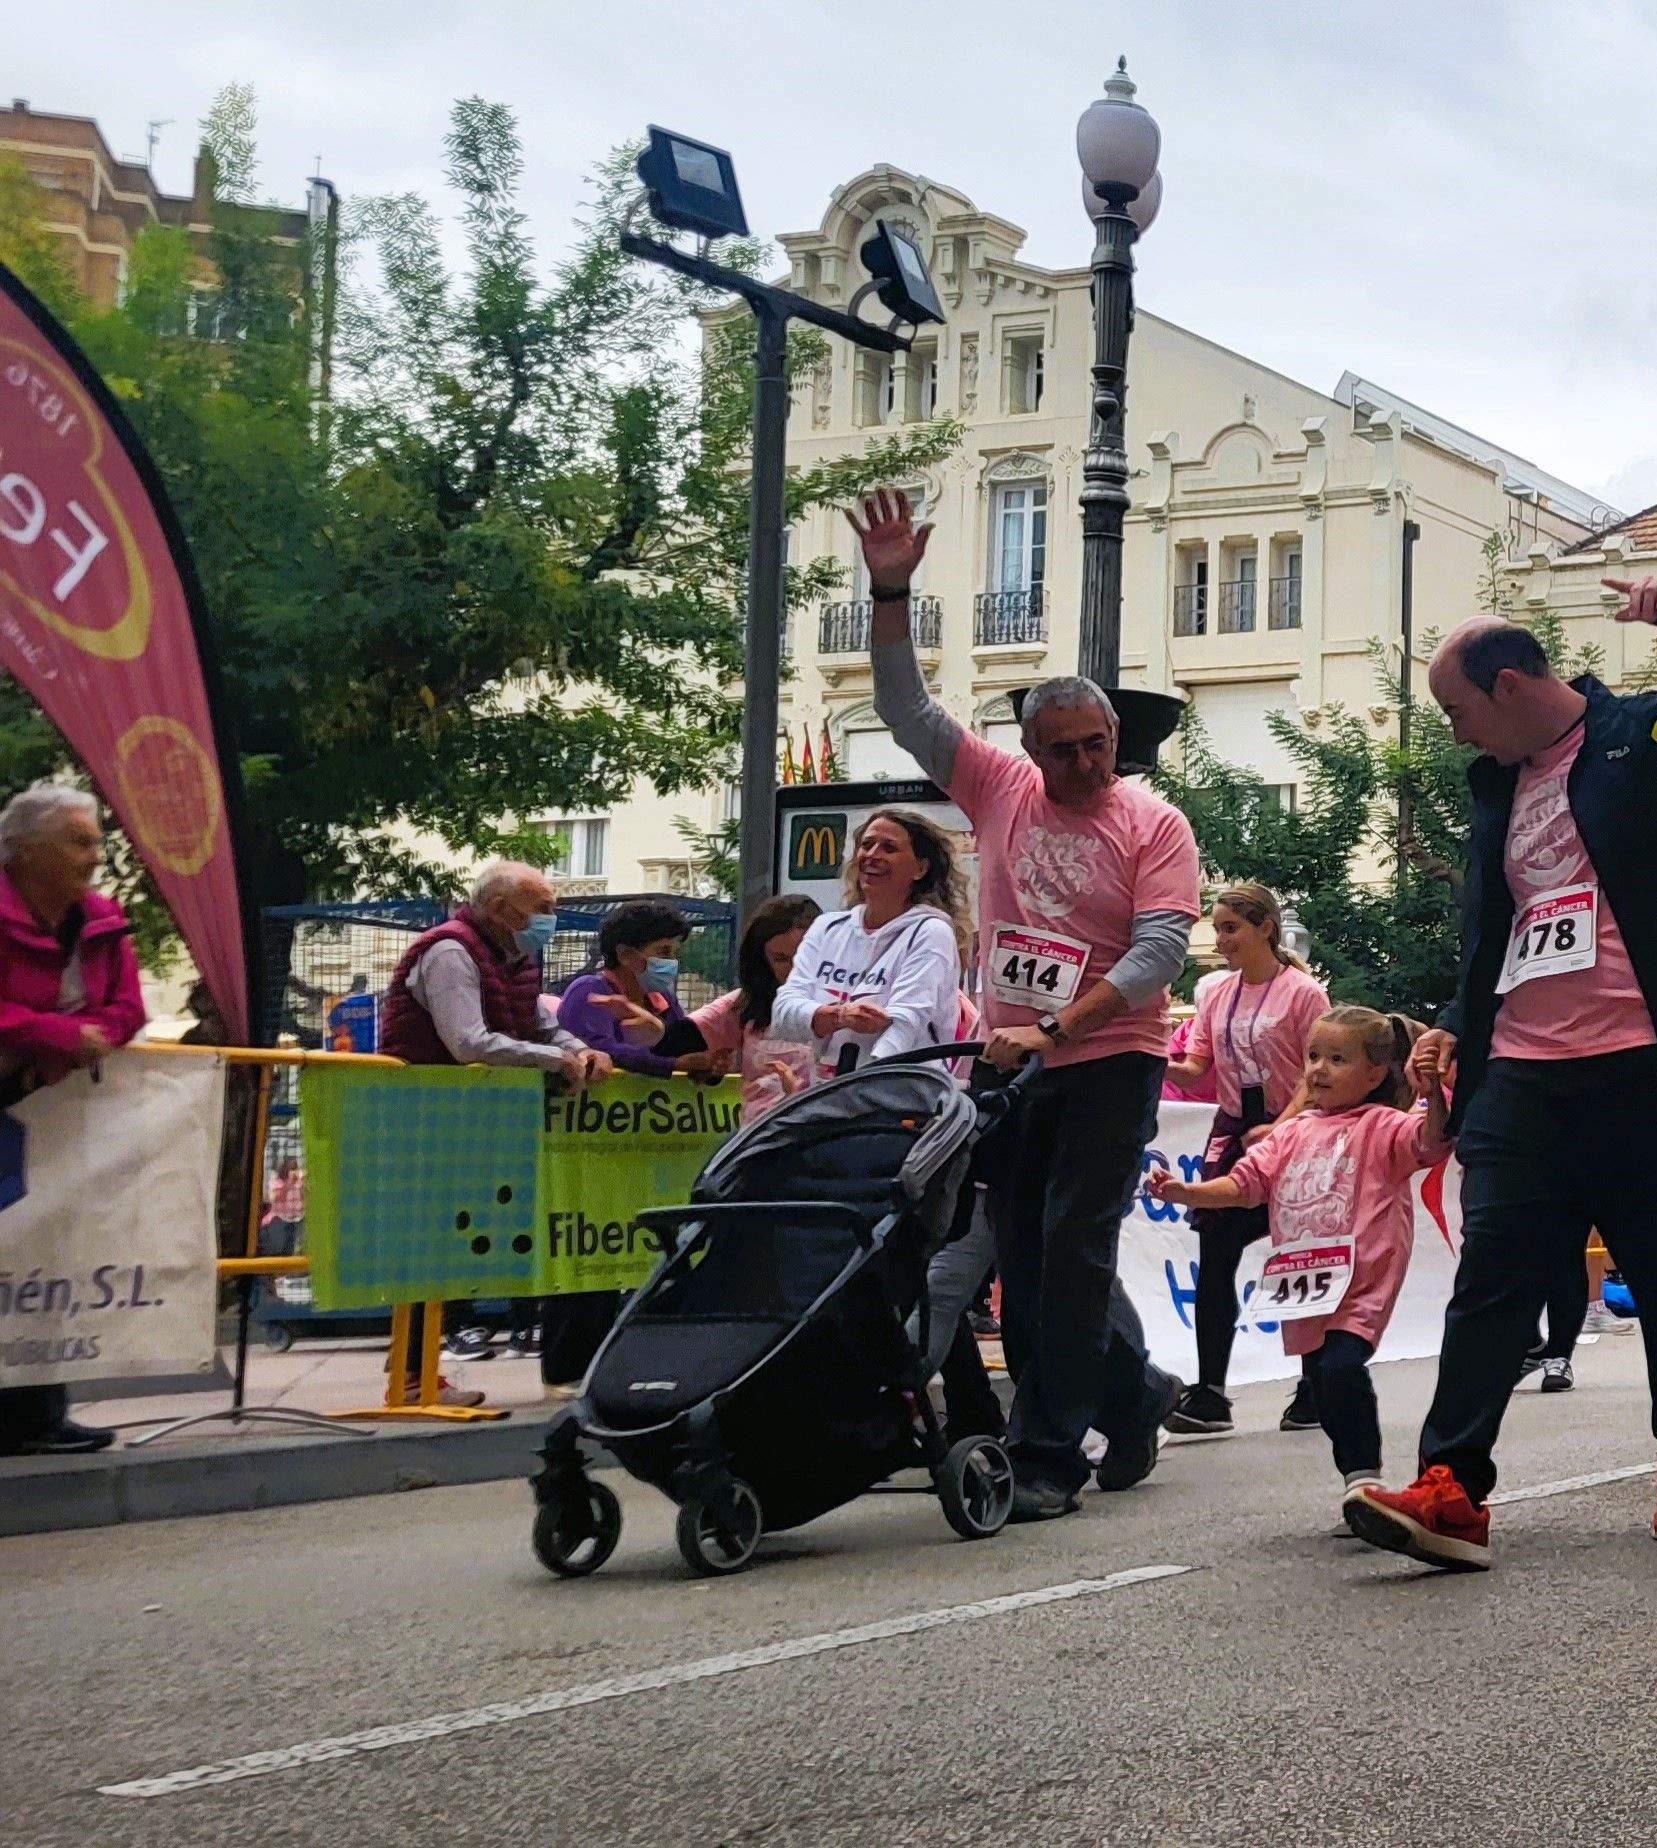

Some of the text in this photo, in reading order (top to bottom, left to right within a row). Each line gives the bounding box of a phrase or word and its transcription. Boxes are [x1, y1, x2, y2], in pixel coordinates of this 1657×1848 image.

[879, 785, 923, 796] URBAN
[1002, 955, 1062, 993] 414
[1268, 1271, 1333, 1304] 415
